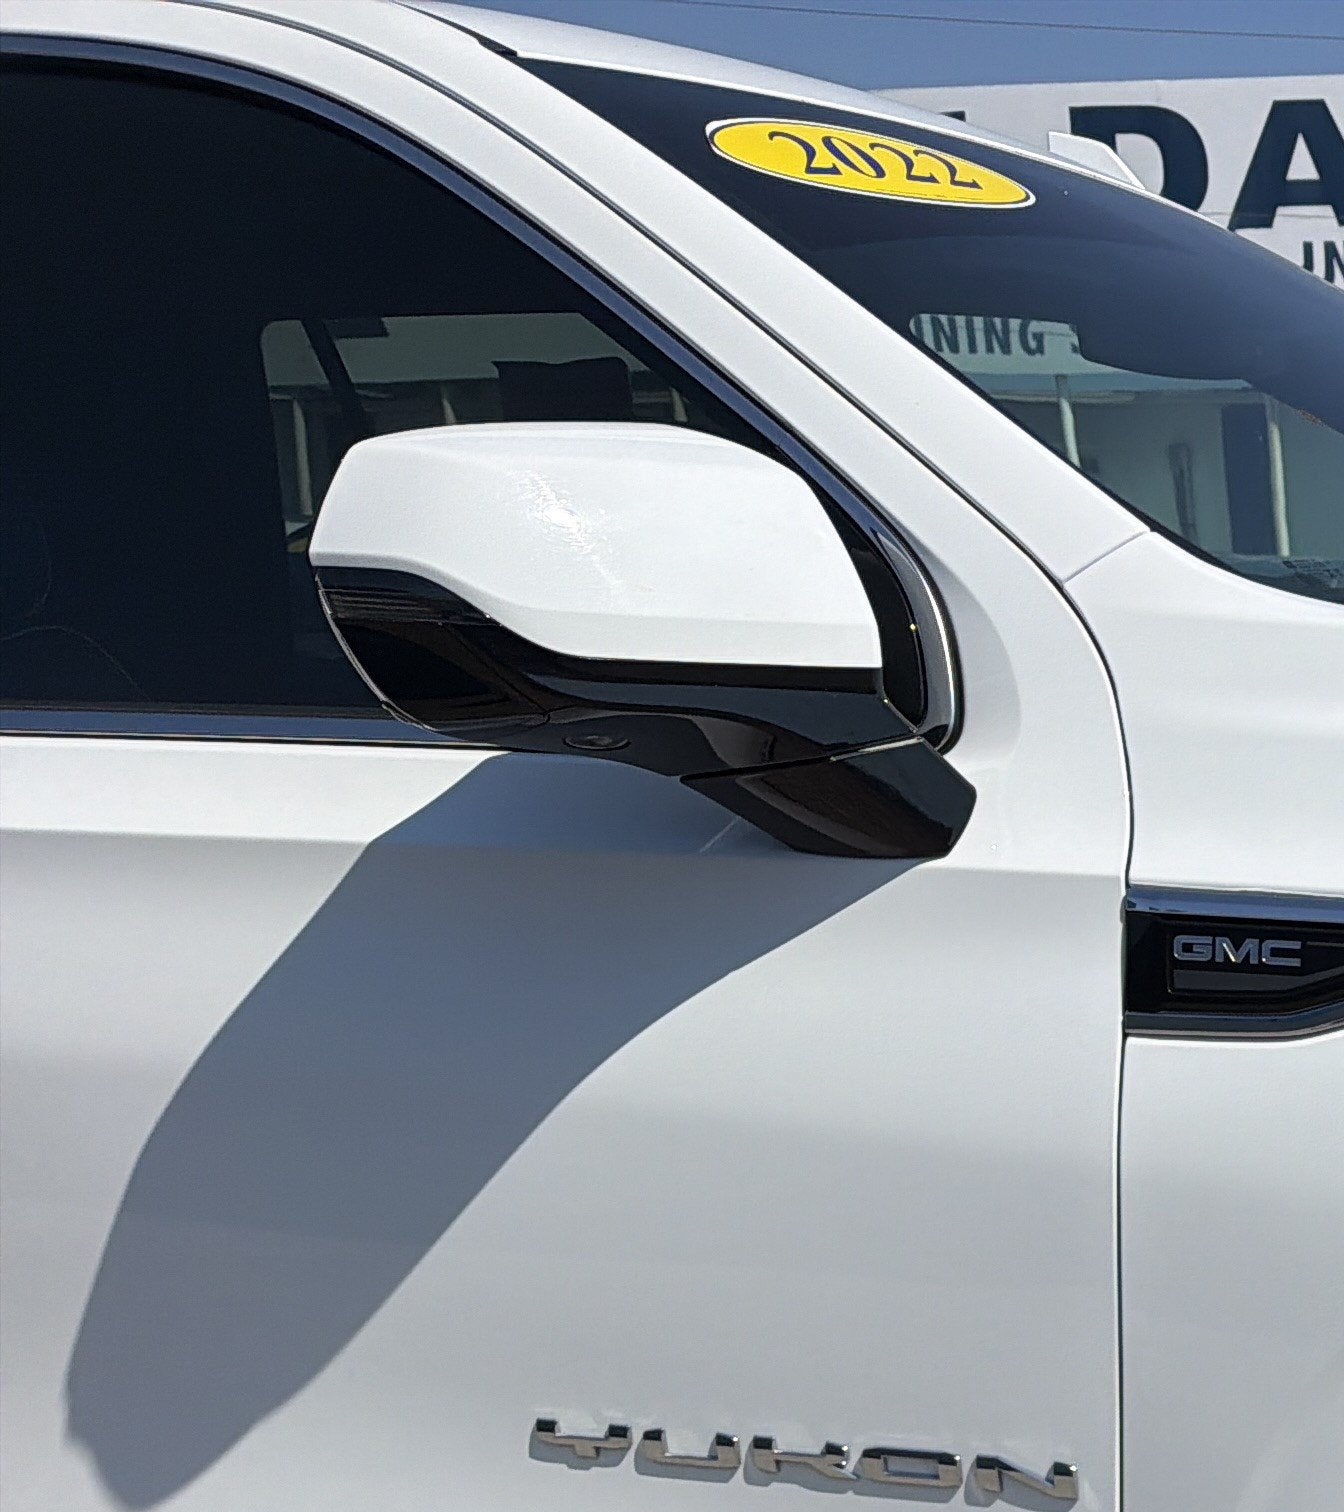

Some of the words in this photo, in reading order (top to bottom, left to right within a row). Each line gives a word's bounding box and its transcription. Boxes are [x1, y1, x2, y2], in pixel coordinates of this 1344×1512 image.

[768, 130, 985, 190] 2022
[1173, 934, 1301, 966] GMC
[530, 1418, 1079, 1501] YUKON
